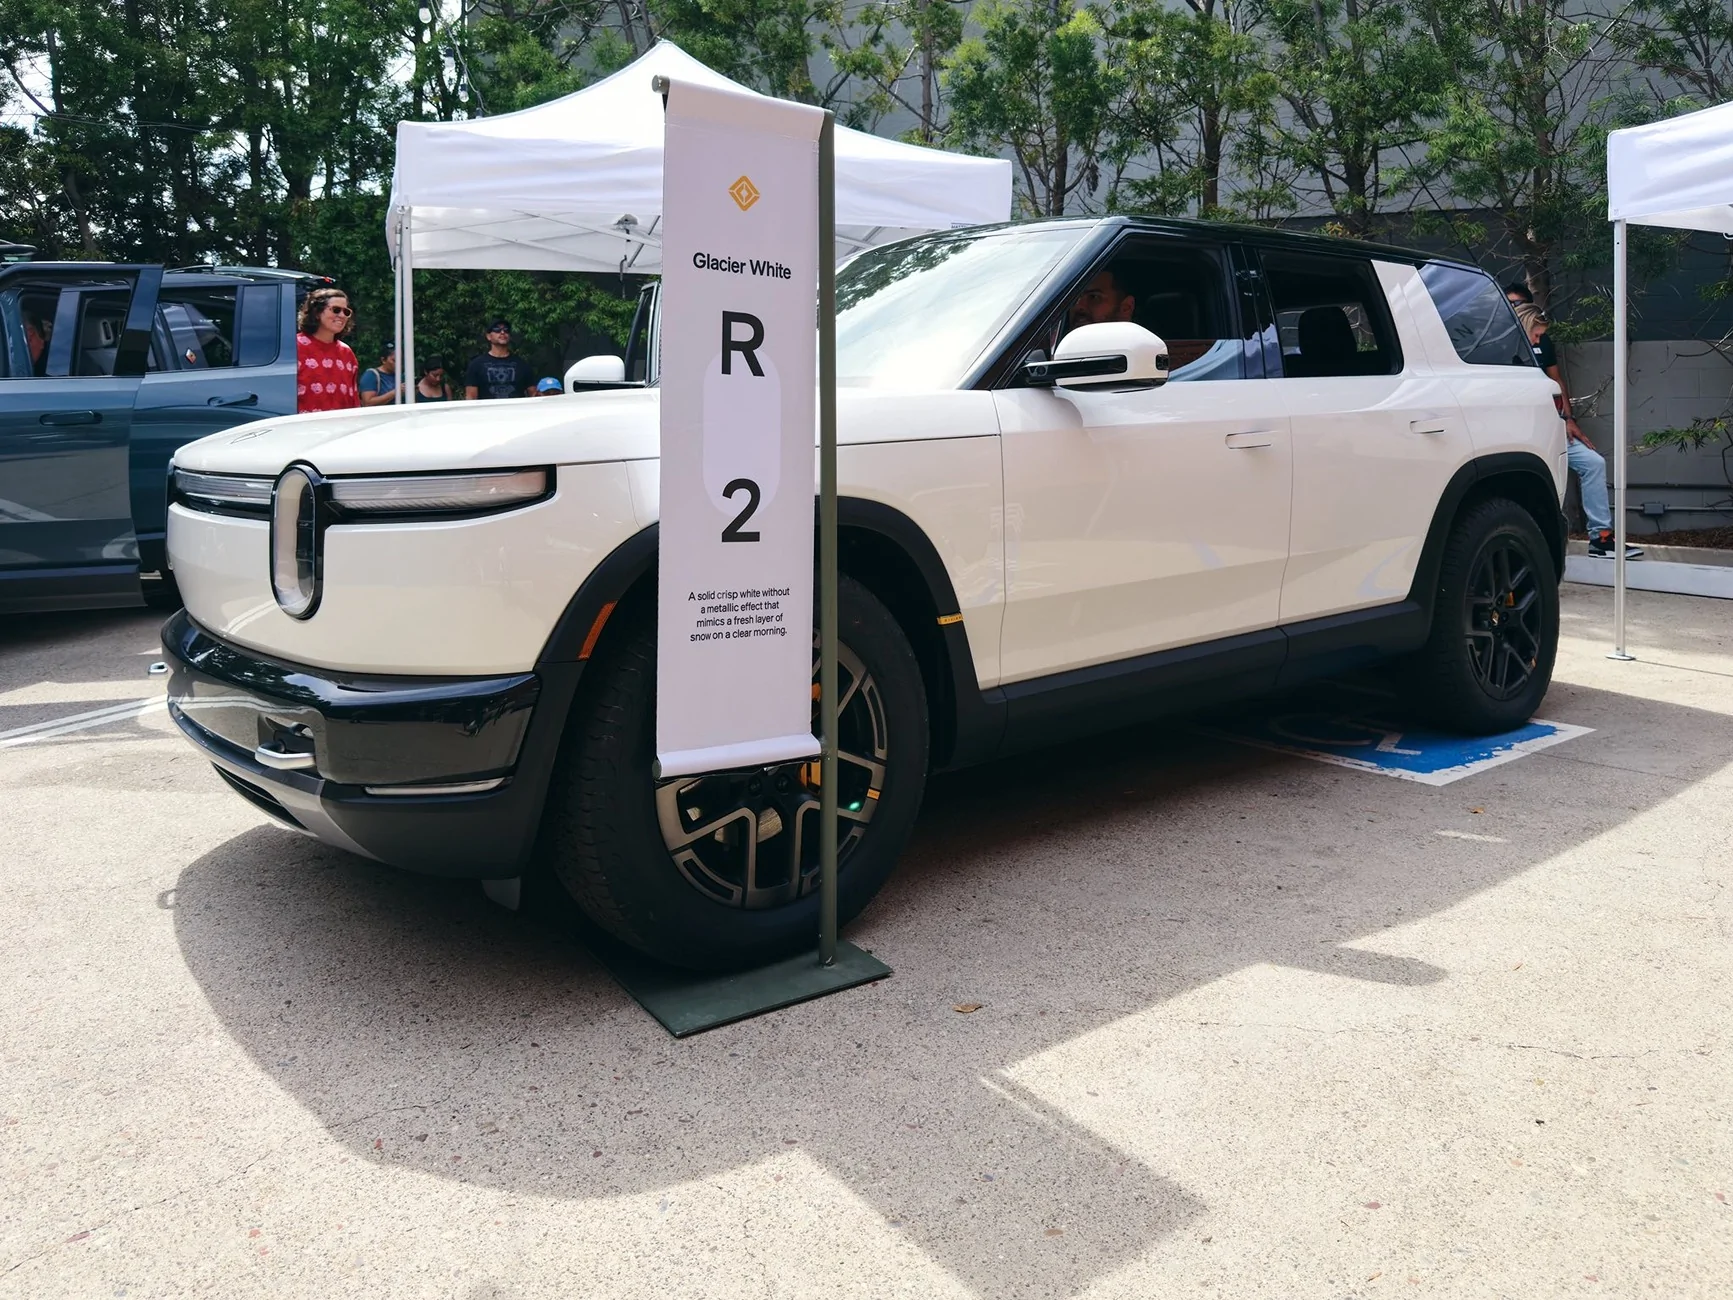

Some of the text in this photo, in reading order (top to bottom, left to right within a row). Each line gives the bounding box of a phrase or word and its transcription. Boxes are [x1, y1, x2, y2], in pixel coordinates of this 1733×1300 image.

[692, 252, 792, 279] Glacier White
[721, 311, 765, 378] R
[721, 478, 761, 542] 2
[688, 587, 790, 601] A solid crisp white without
[700, 601, 779, 614] a metallic effect that
[696, 613, 783, 628] mimics a fresh layer of
[690, 626, 787, 642] snow on a clear morning.
